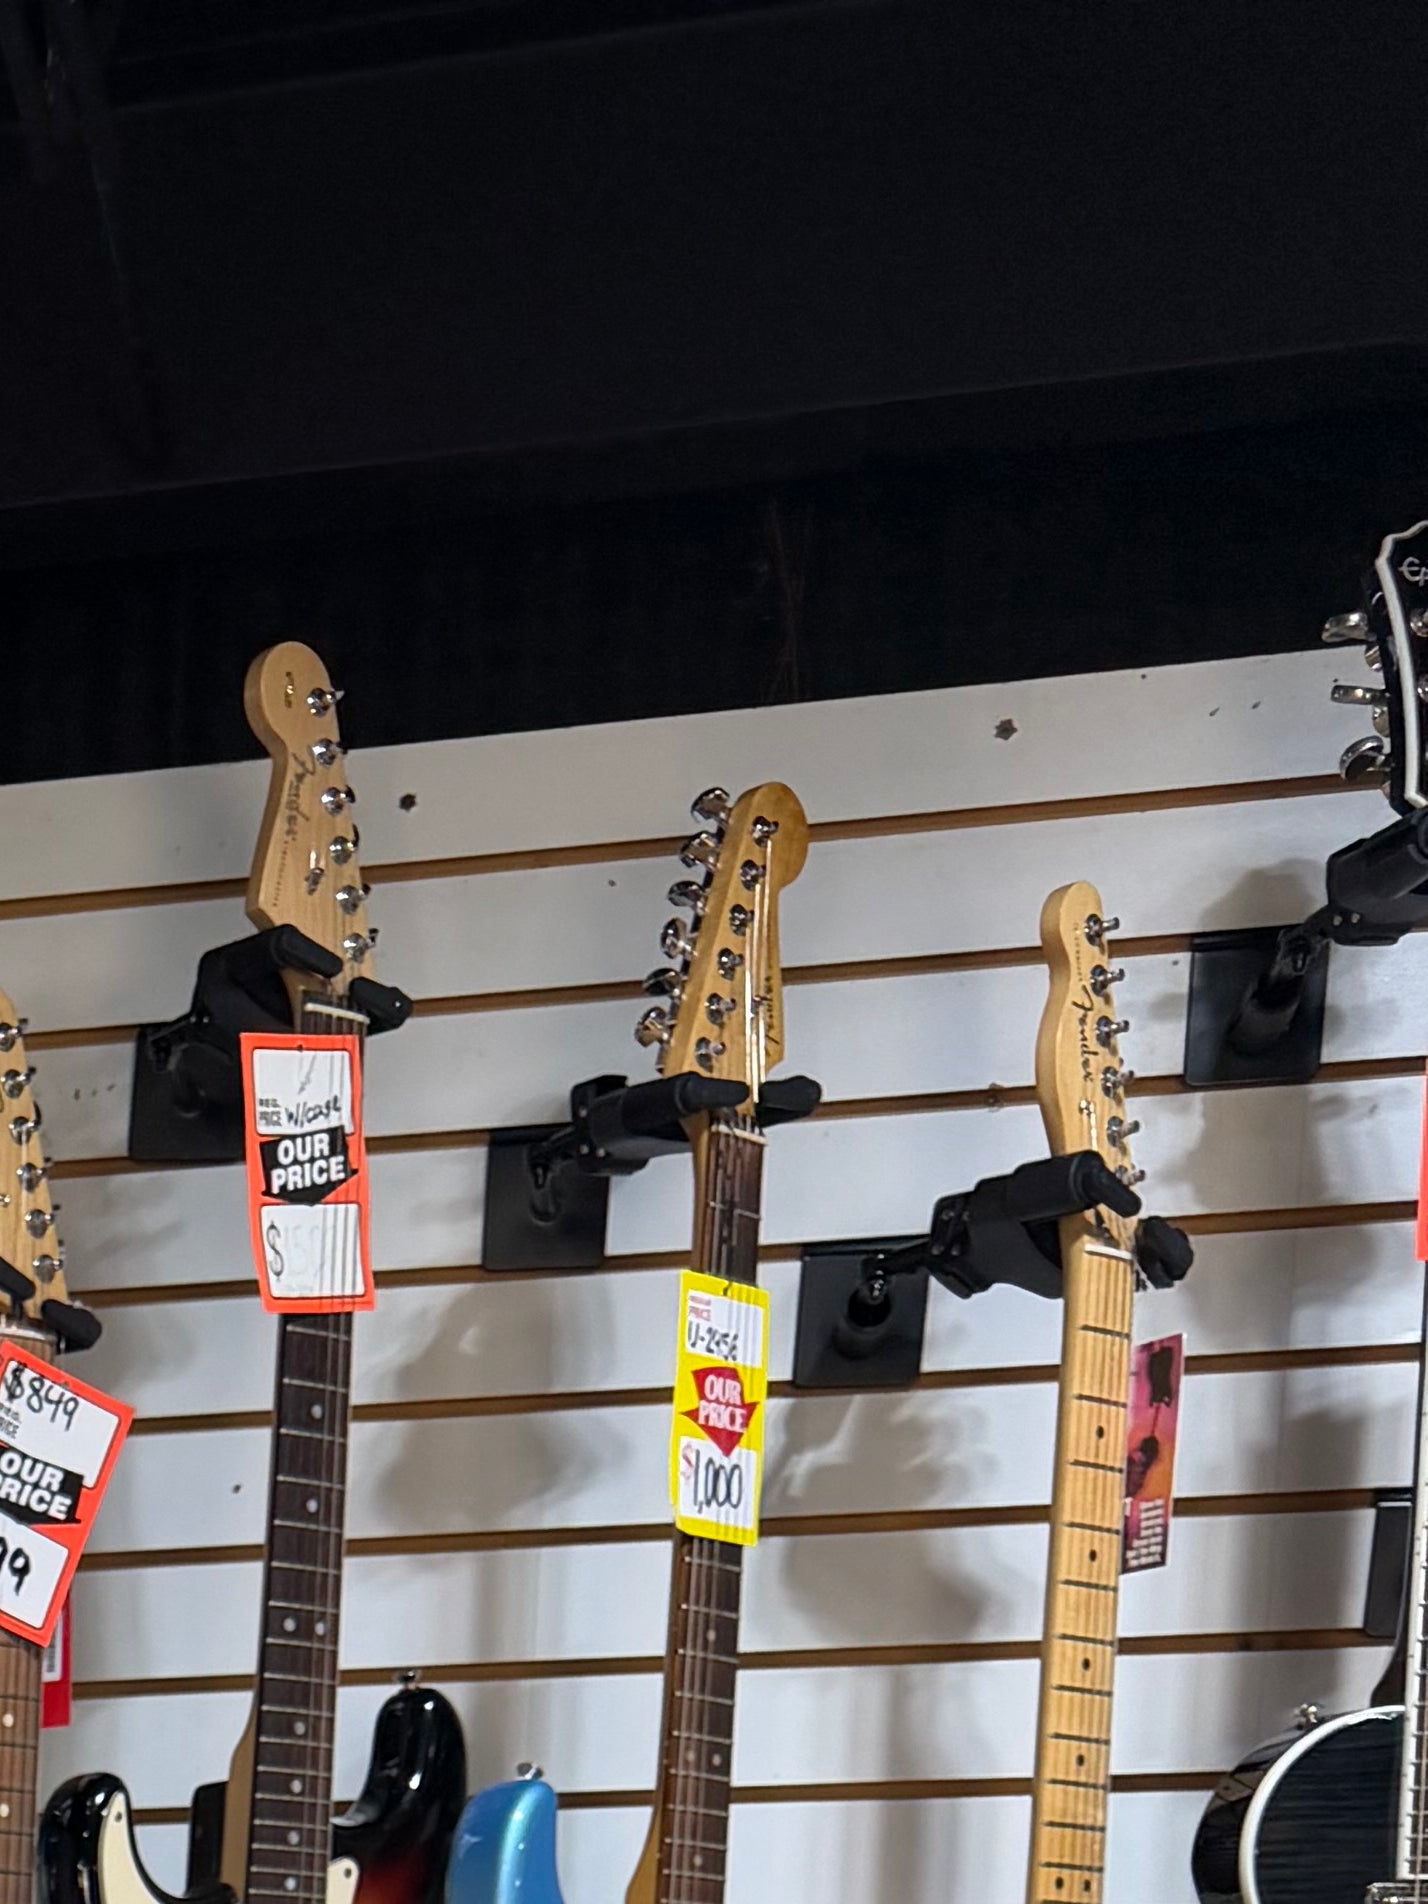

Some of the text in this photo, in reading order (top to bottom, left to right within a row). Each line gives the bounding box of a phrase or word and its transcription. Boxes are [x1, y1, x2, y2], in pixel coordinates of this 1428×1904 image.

[1072, 984, 1099, 1083] Fender
[277, 1133, 330, 1165] OUR
[270, 1156, 347, 1196] PRICE
[3, 1361, 80, 1432] $849
[704, 1375, 743, 1405] OUR
[699, 1400, 746, 1432] PRICE
[682, 1443, 743, 1514] $1,000
